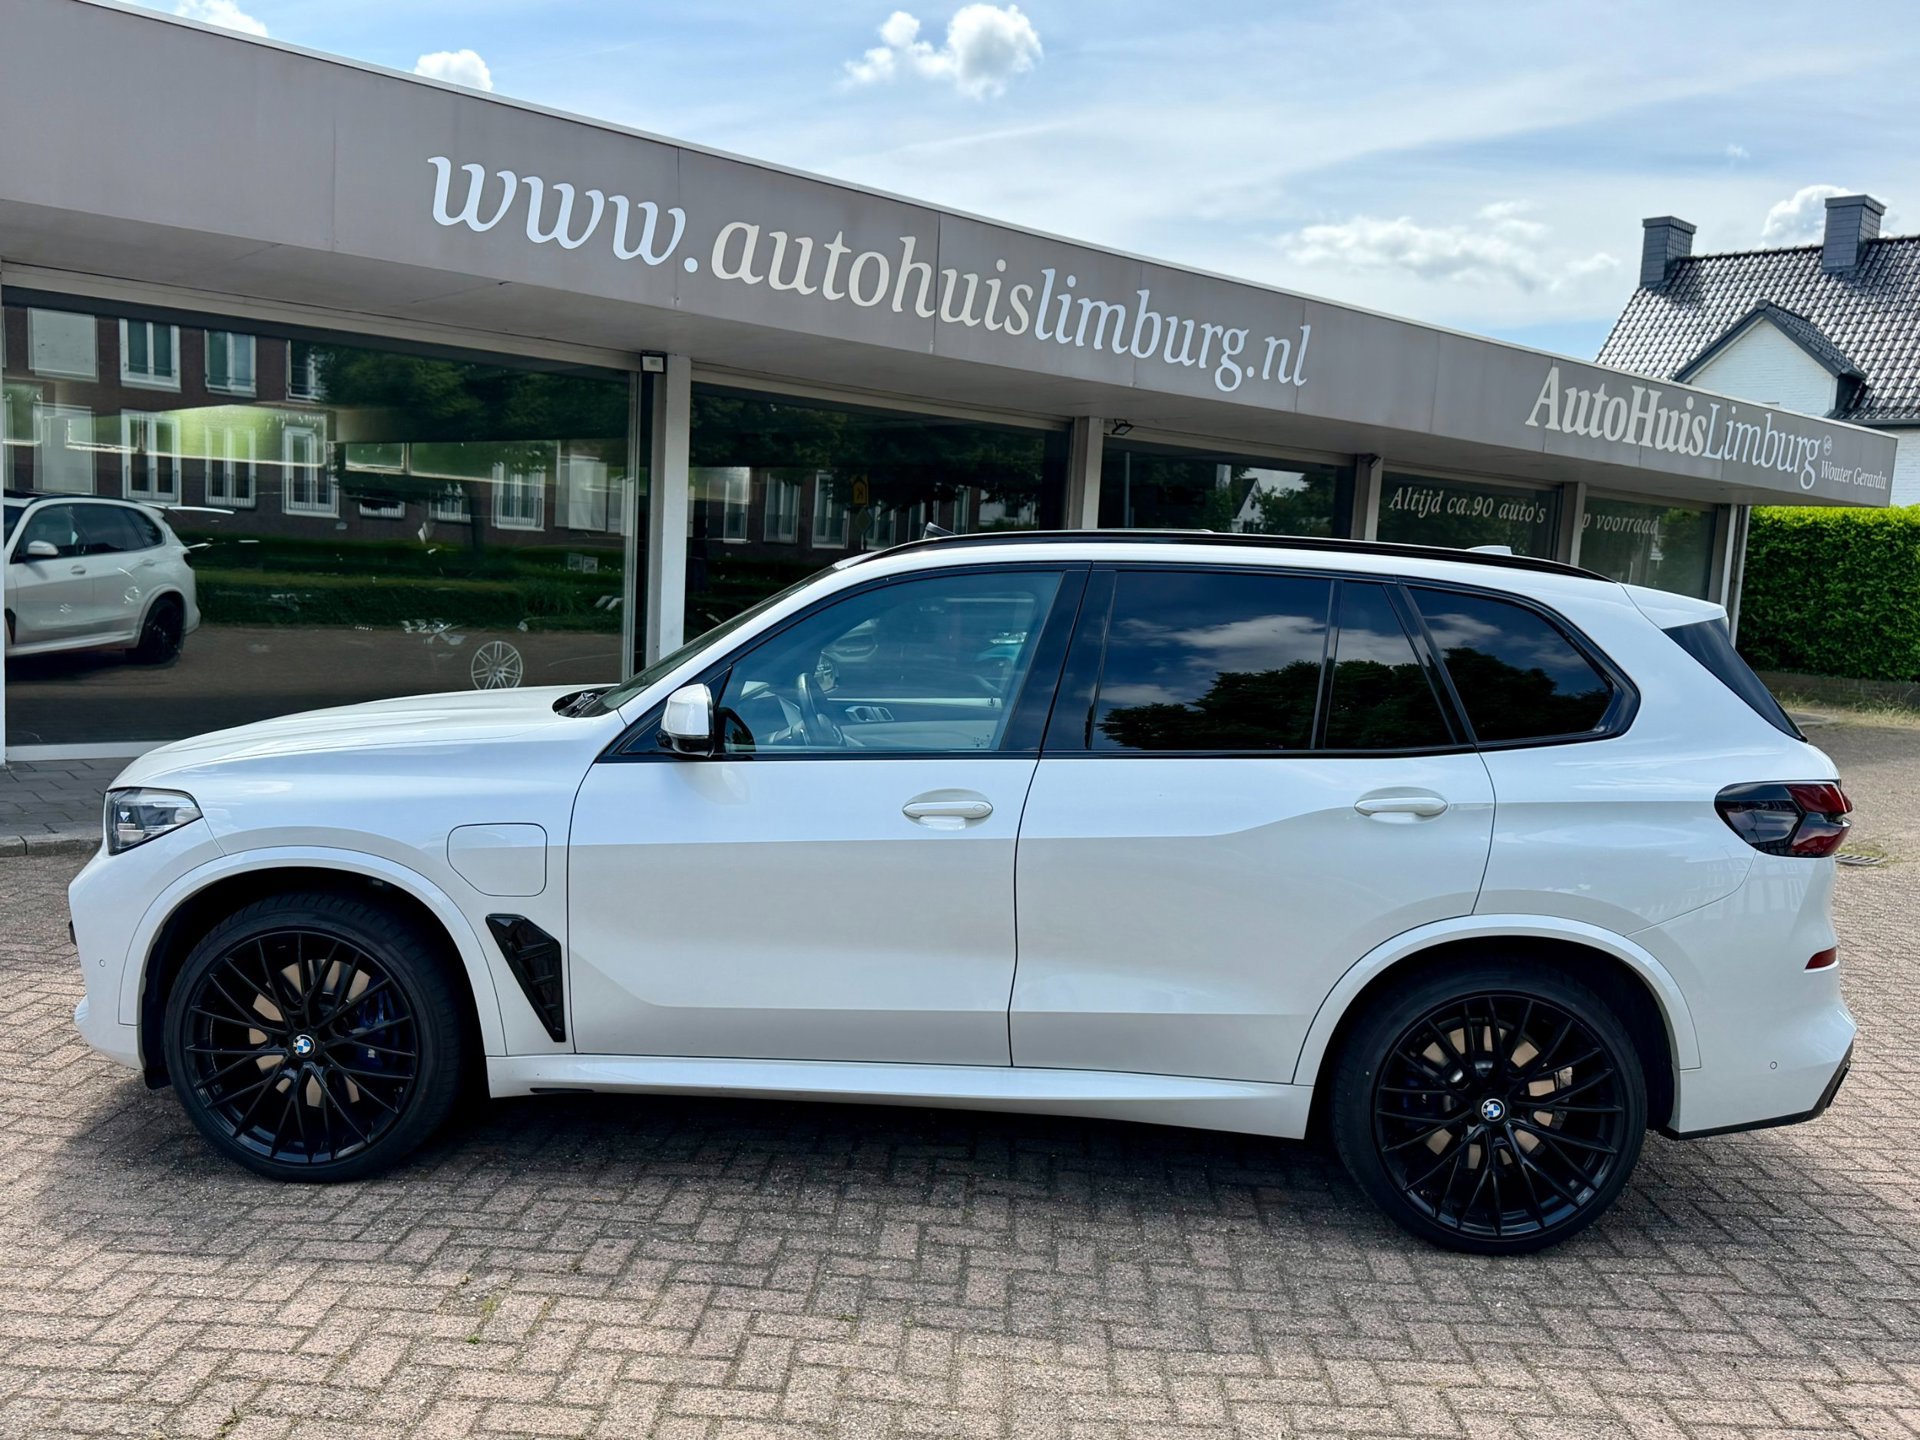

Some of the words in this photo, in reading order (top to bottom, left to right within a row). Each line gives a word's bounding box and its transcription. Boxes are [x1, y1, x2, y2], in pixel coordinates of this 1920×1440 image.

[427, 156, 1311, 392] www.autohuislimburg.nl
[1525, 366, 1821, 490] AutoHuisLimburg
[1388, 486, 1444, 519] Altijd
[1498, 502, 1547, 524] auto's
[1596, 515, 1660, 535] voorraad
[1821, 460, 1853, 484] Wouter
